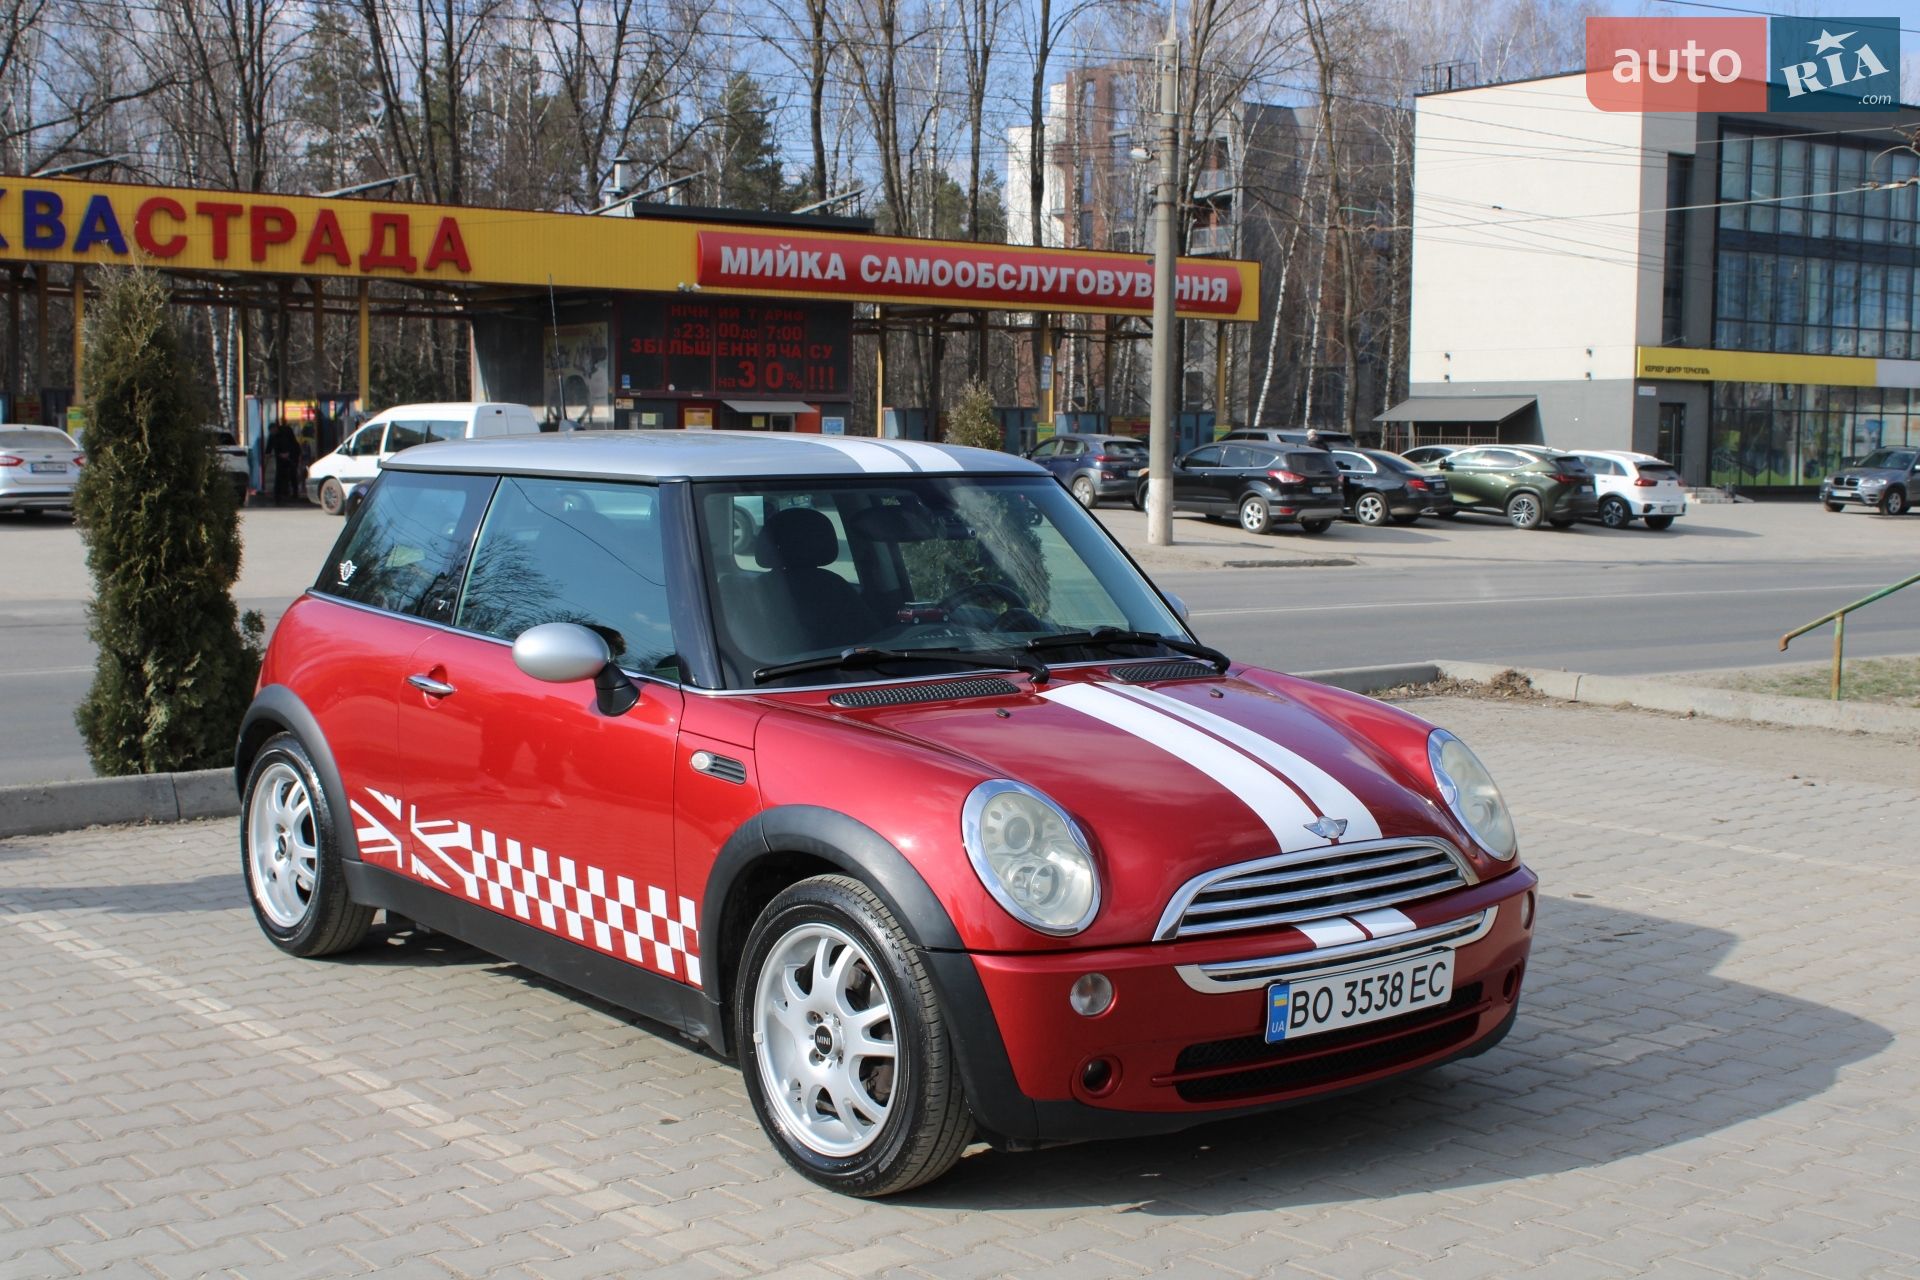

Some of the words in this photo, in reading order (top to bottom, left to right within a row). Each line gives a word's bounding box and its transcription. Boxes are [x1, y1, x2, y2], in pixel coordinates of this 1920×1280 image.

[720, 243, 846, 280] МИЙКА
[860, 254, 1228, 303] САМООБСЛУГОВУВННЯ
[1289, 986, 1334, 1030] BO
[1341, 970, 1405, 1019] 3538
[1409, 961, 1447, 1004] EC
[815, 1034, 831, 1046] MINI
[1271, 1020, 1286, 1034] UA
